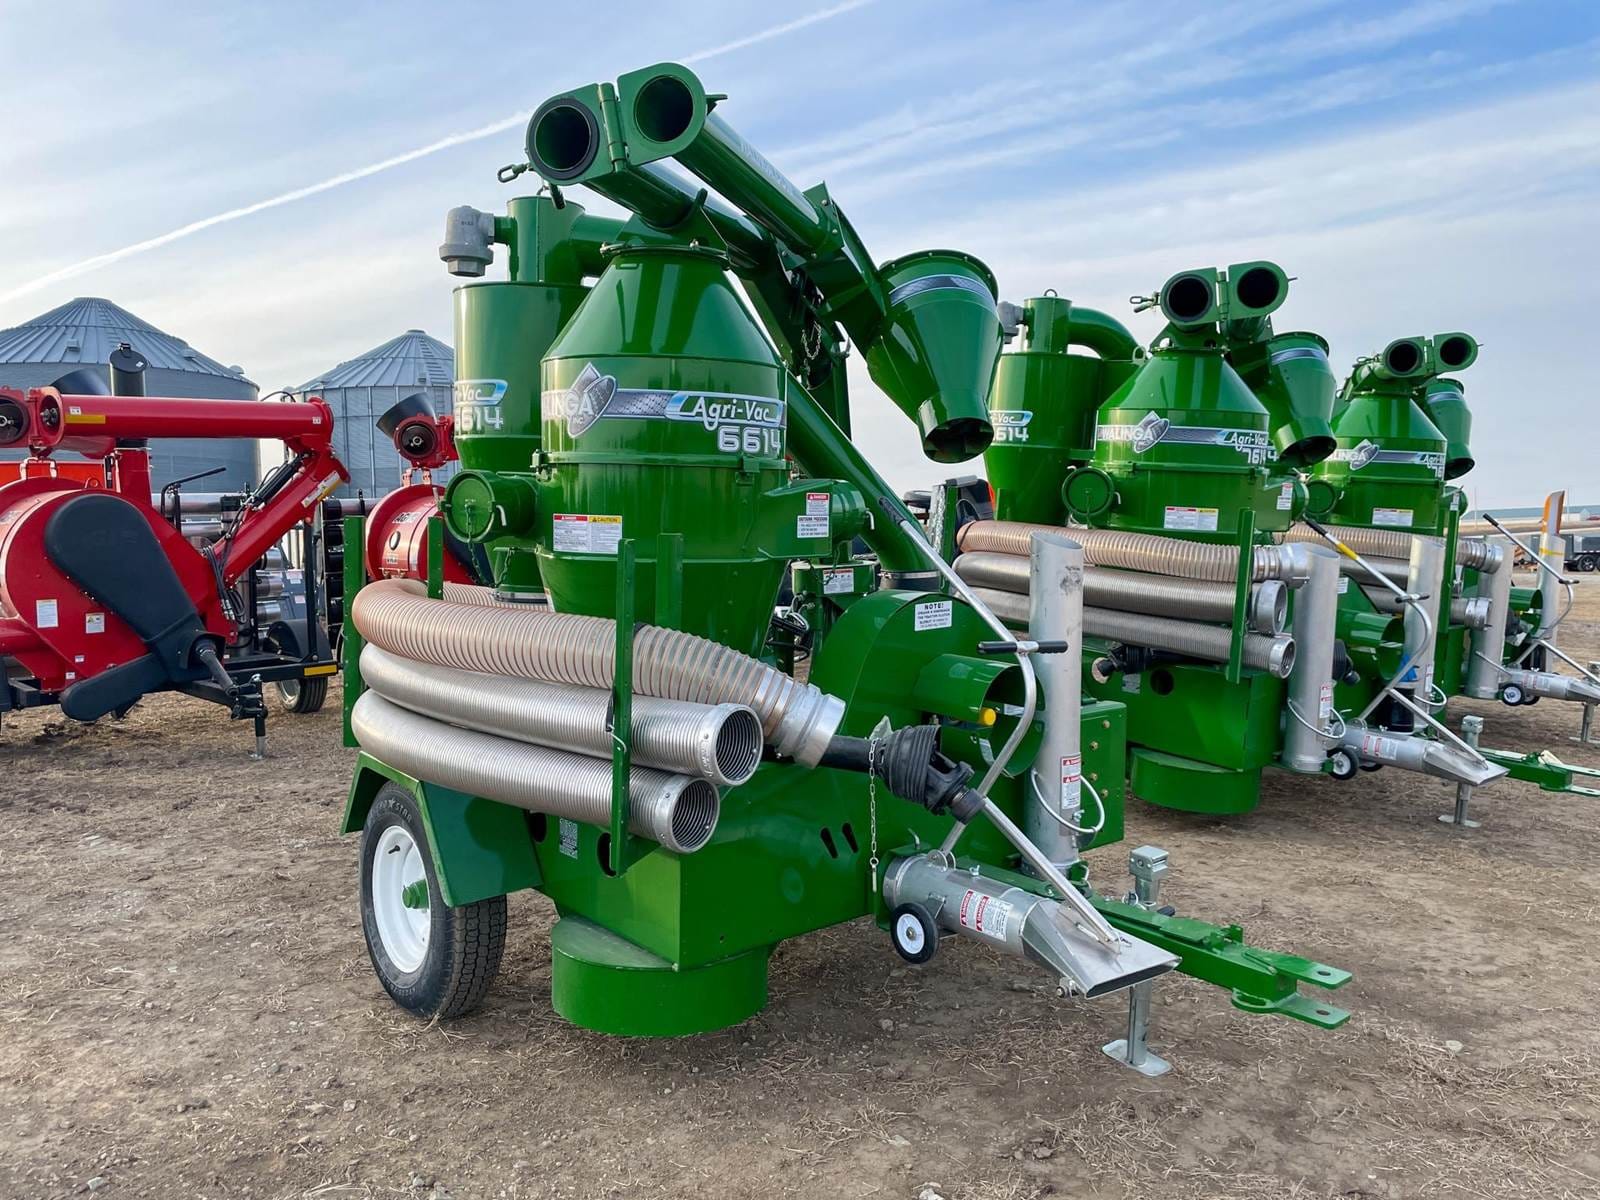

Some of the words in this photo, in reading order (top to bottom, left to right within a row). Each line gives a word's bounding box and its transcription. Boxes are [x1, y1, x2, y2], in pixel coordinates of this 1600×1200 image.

[692, 395, 770, 431] Agri-Vac
[718, 425, 781, 455] 6614
[993, 426, 1029, 442] 614
[924, 602, 944, 610] NOTE!
